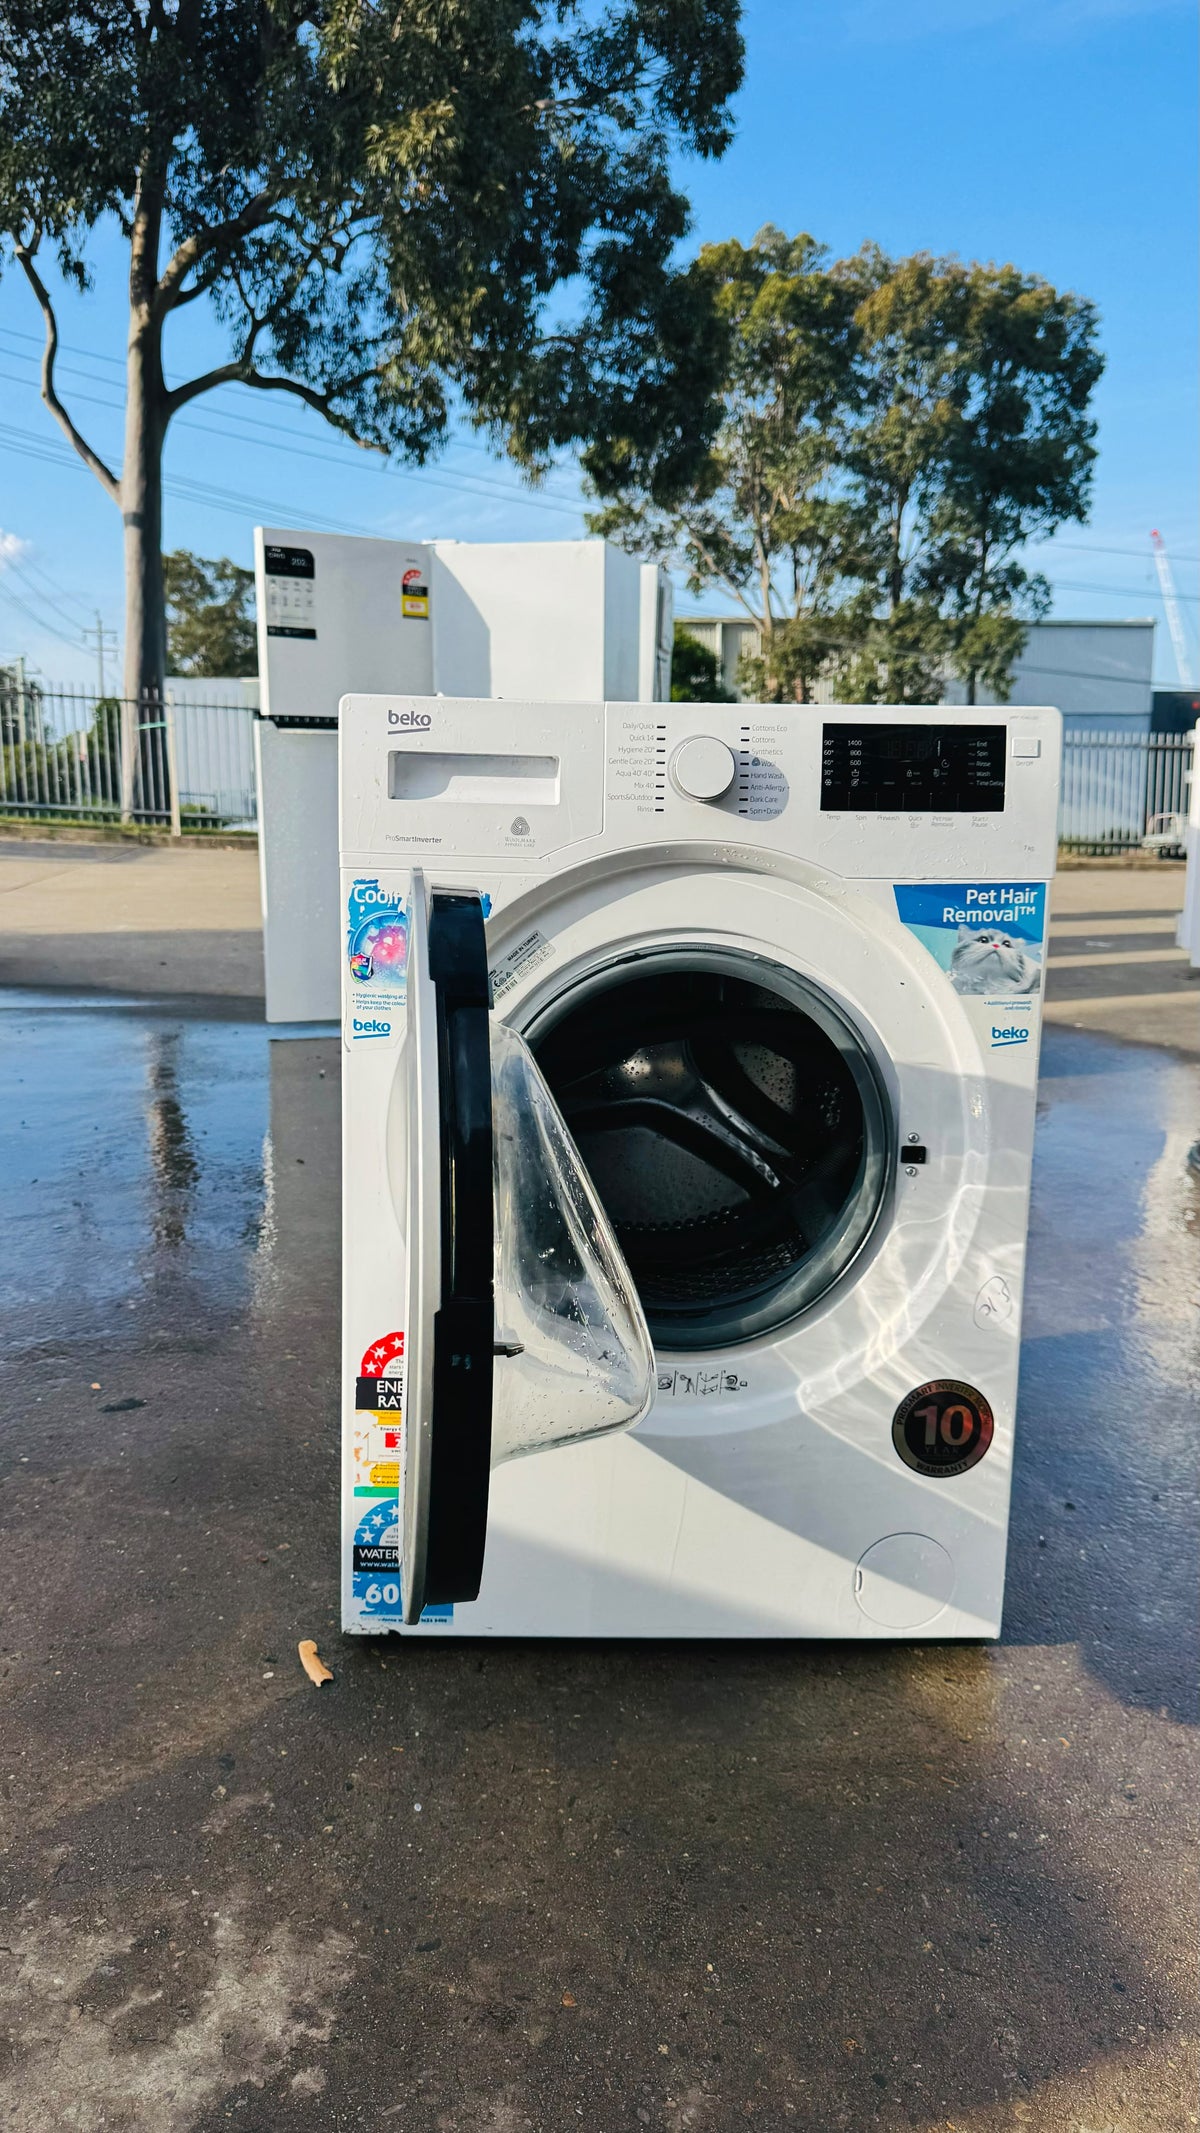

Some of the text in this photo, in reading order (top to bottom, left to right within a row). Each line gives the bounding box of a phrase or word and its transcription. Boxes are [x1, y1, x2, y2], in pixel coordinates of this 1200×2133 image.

[388, 710, 432, 726] beko
[629, 734, 645, 742] Quick
[751, 748, 783, 756] Synthetics
[608, 757, 629, 765] Gentle
[385, 834, 443, 844] ProSmartInverter
[966, 888, 1038, 904] Pet Hair
[353, 1018, 391, 1032] beko
[991, 1026, 1030, 1039] beko
[897, 1385, 934, 1426] PROSMART
[914, 1405, 974, 1446] 10
[915, 1459, 969, 1475] WARRANTY
[359, 1548, 400, 1560] WATER
[365, 1583, 400, 1605] 60
